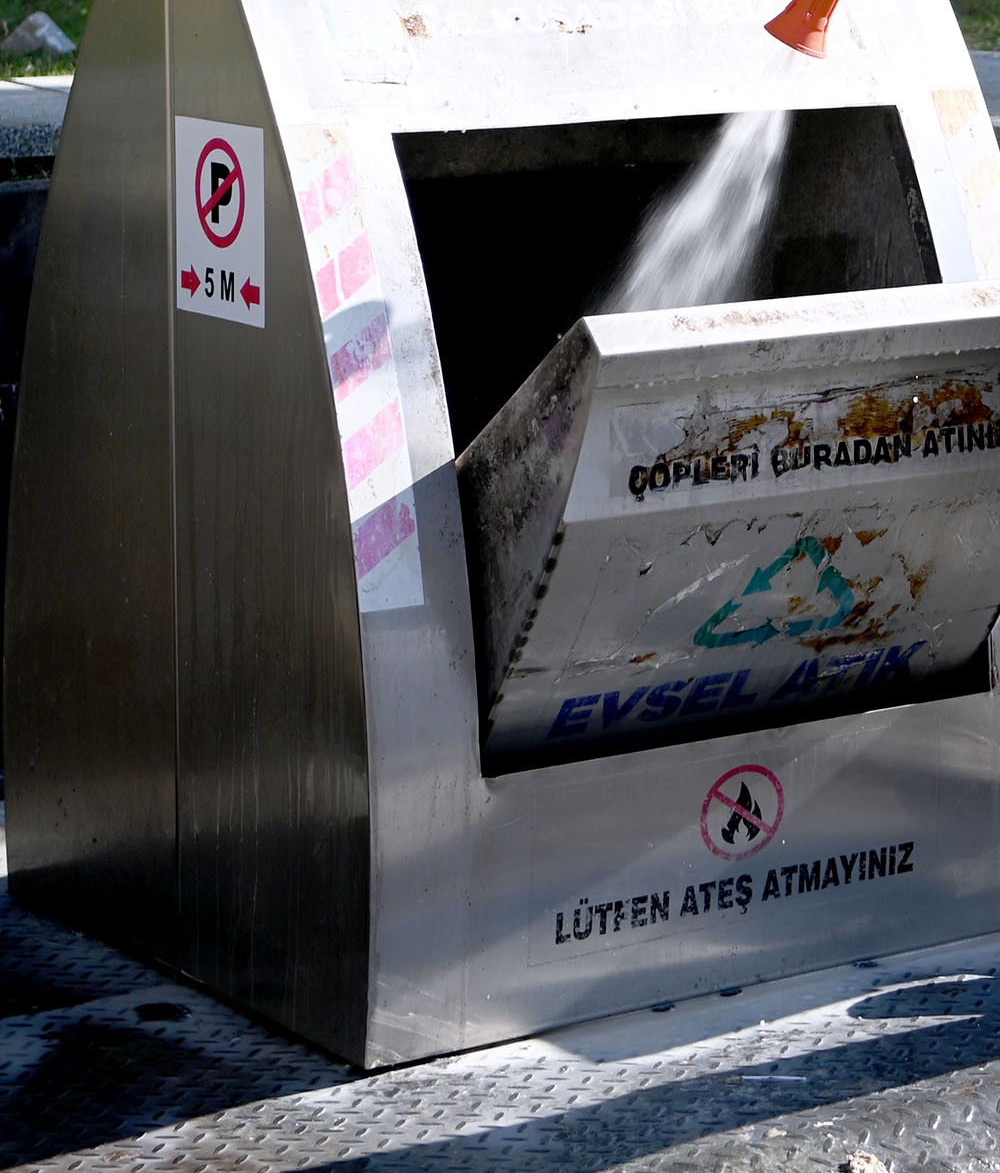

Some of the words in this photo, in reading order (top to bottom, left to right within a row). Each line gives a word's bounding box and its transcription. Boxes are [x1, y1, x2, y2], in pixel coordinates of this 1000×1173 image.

[204, 266, 215, 298] 5
[220, 269, 235, 303] M
[770, 430, 915, 478] BURADAN
[545, 668, 761, 740] EVSEL
[769, 639, 928, 703] ATIK
[555, 890, 671, 945] LÜTFEN
[679, 873, 753, 916] ATEŞ
[760, 840, 915, 903] ATMAYINIZ
